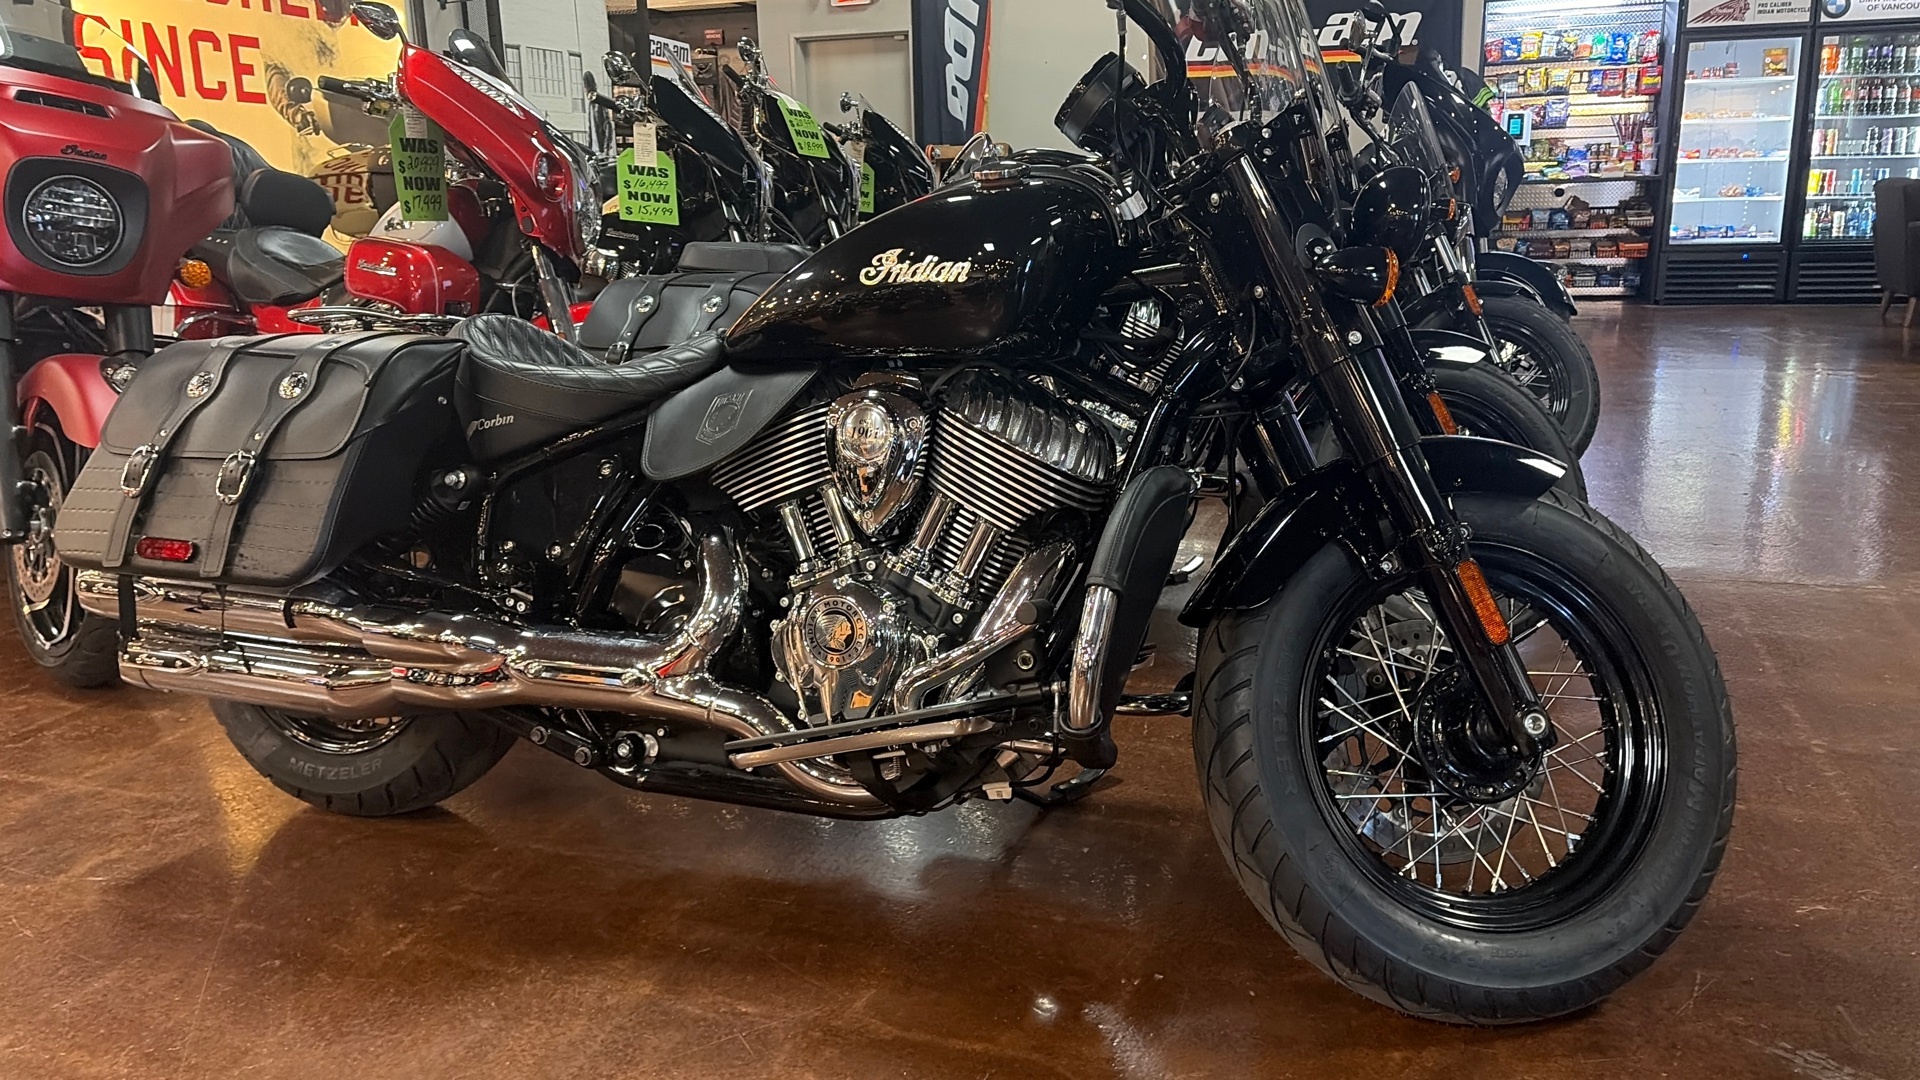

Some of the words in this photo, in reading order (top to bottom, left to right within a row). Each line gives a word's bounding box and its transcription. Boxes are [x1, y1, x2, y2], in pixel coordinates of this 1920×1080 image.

[74, 13, 267, 104] SINCE
[786, 107, 811, 119] WAS
[794, 128, 820, 140] NOW
[399, 138, 439, 154] WAS
[627, 164, 669, 178] WAS
[403, 176, 440, 191] NOW
[627, 191, 671, 204] NOW
[859, 248, 971, 286] Indian
[478, 414, 514, 430] Corbin
[807, 608, 821, 649] INDIAN
[823, 600, 864, 653] MOTORCYCLE
[824, 654, 846, 662] 1901
[289, 757, 383, 780] METZELER
